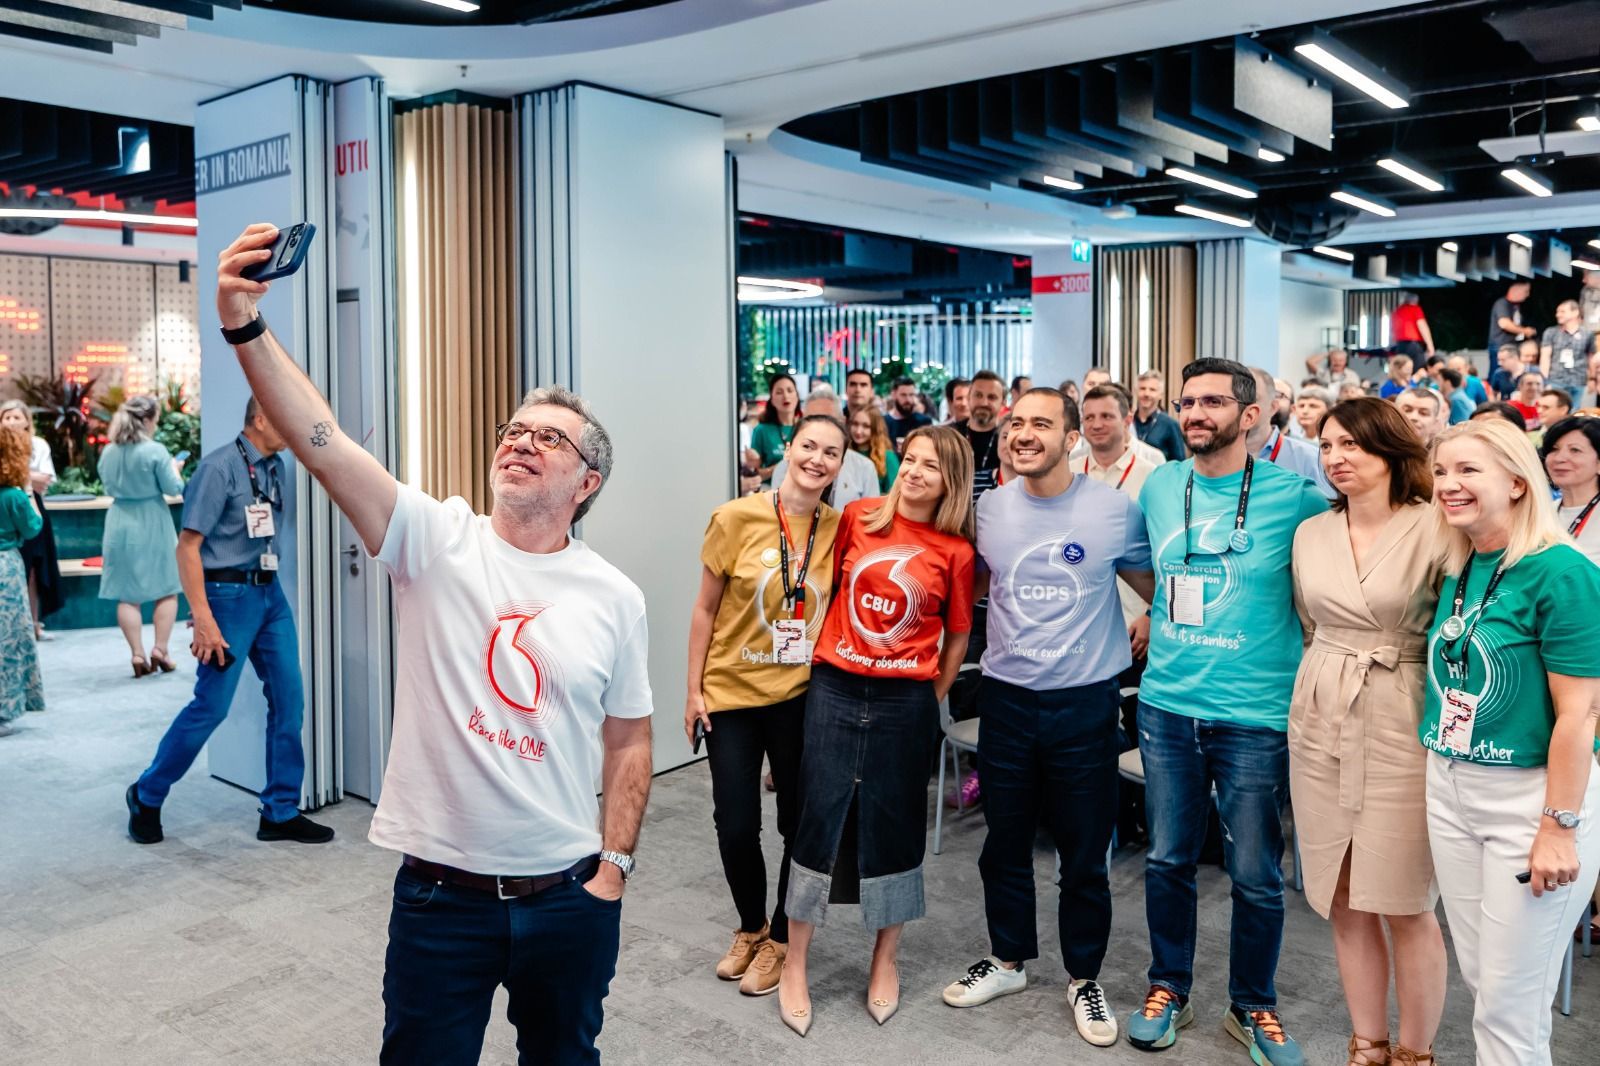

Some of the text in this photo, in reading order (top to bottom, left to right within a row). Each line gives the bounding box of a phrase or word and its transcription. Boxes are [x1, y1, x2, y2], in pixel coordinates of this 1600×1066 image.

[211, 154, 225, 188] IN
[228, 137, 290, 184] ROMANIA
[1020, 584, 1070, 601] COPS
[861, 593, 896, 615] CBU
[1190, 633, 1240, 650] seamless
[742, 647, 773, 665] Digital
[835, 639, 918, 669] Customer obsessed
[469, 715, 548, 758] Race like ONE
